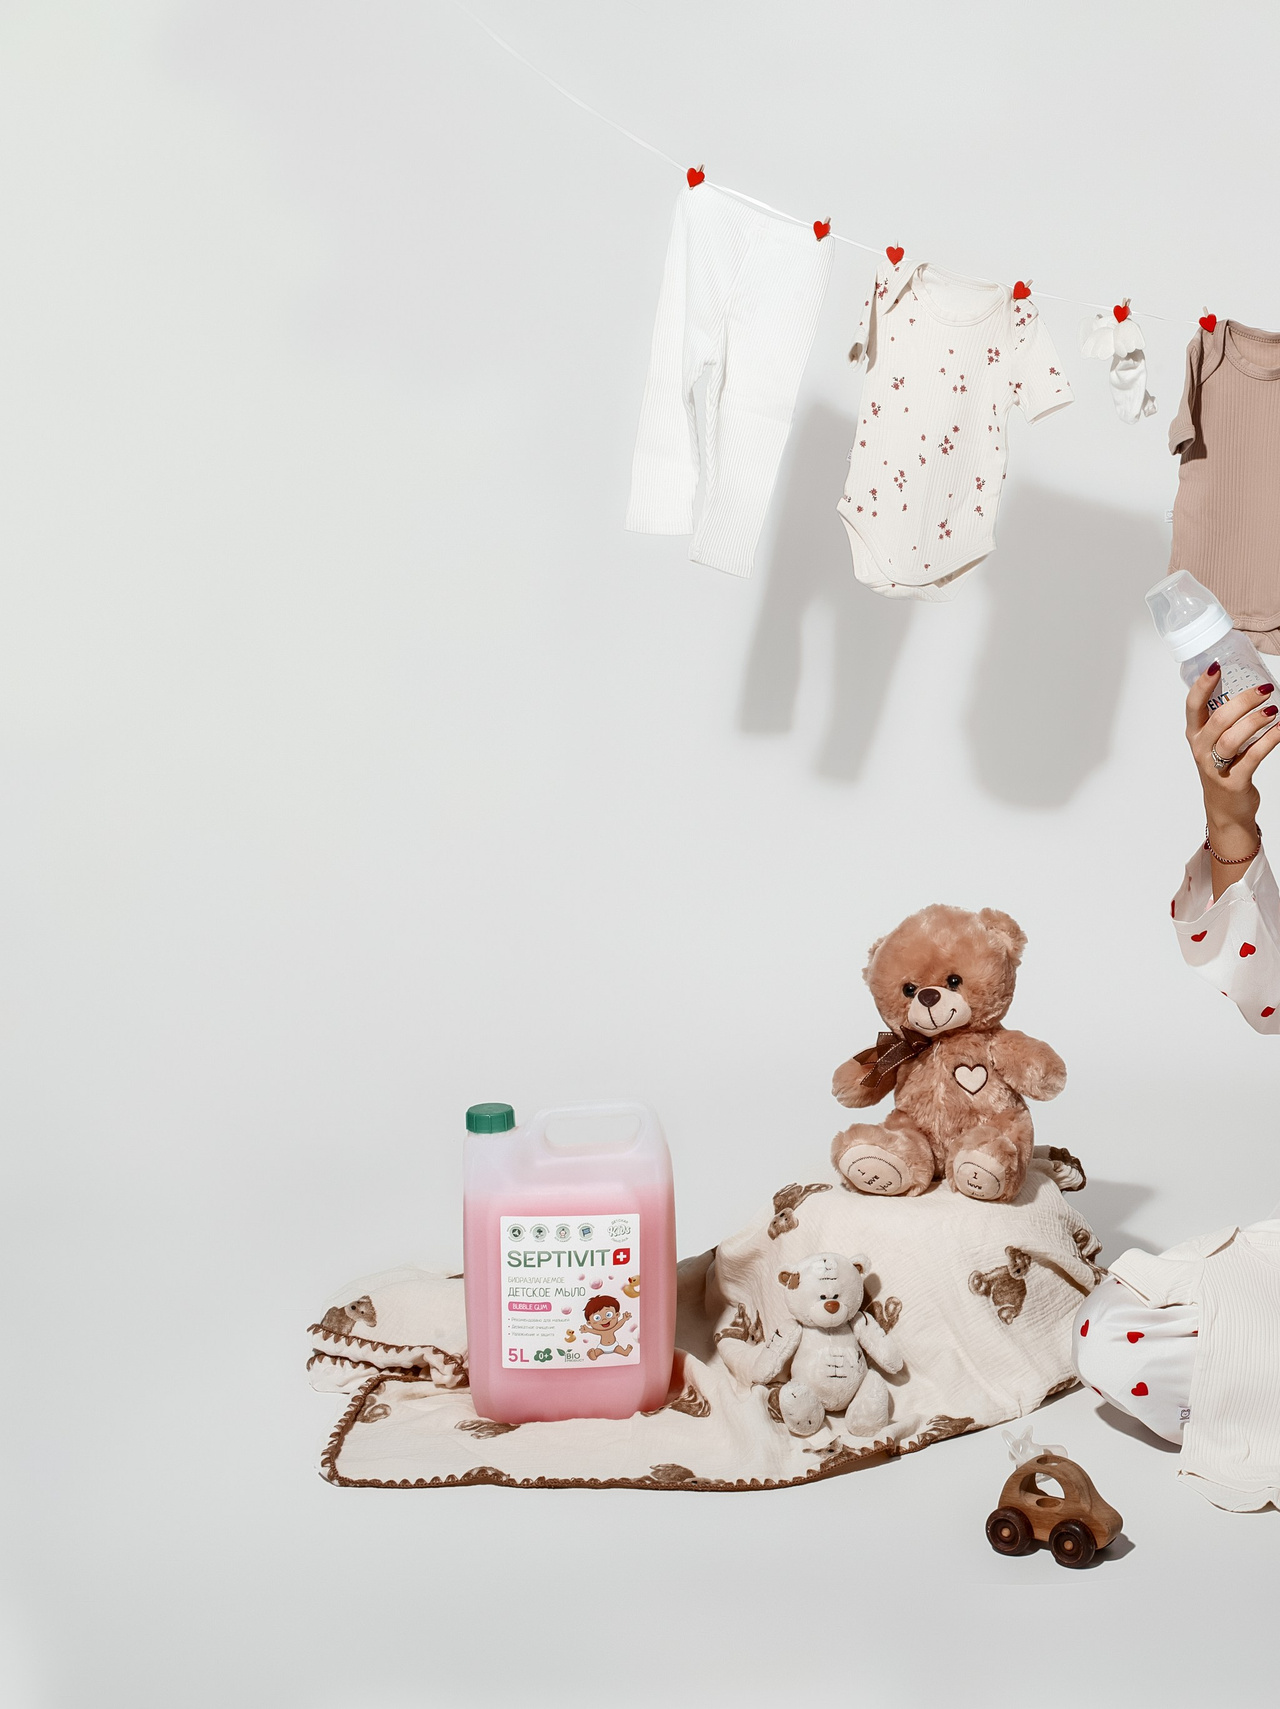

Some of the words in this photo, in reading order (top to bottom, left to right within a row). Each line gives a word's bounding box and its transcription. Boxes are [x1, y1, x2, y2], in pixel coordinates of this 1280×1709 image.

[507, 1249, 611, 1268] SEPTIVIT
[508, 1276, 565, 1284] БИОРАЗЛАГАЕМОЕ
[508, 1287, 551, 1298] ДЕТСКОЕ
[554, 1287, 586, 1298] МЫЛО
[539, 1352, 549, 1360] 0+
[566, 1352, 581, 1360] BIO
